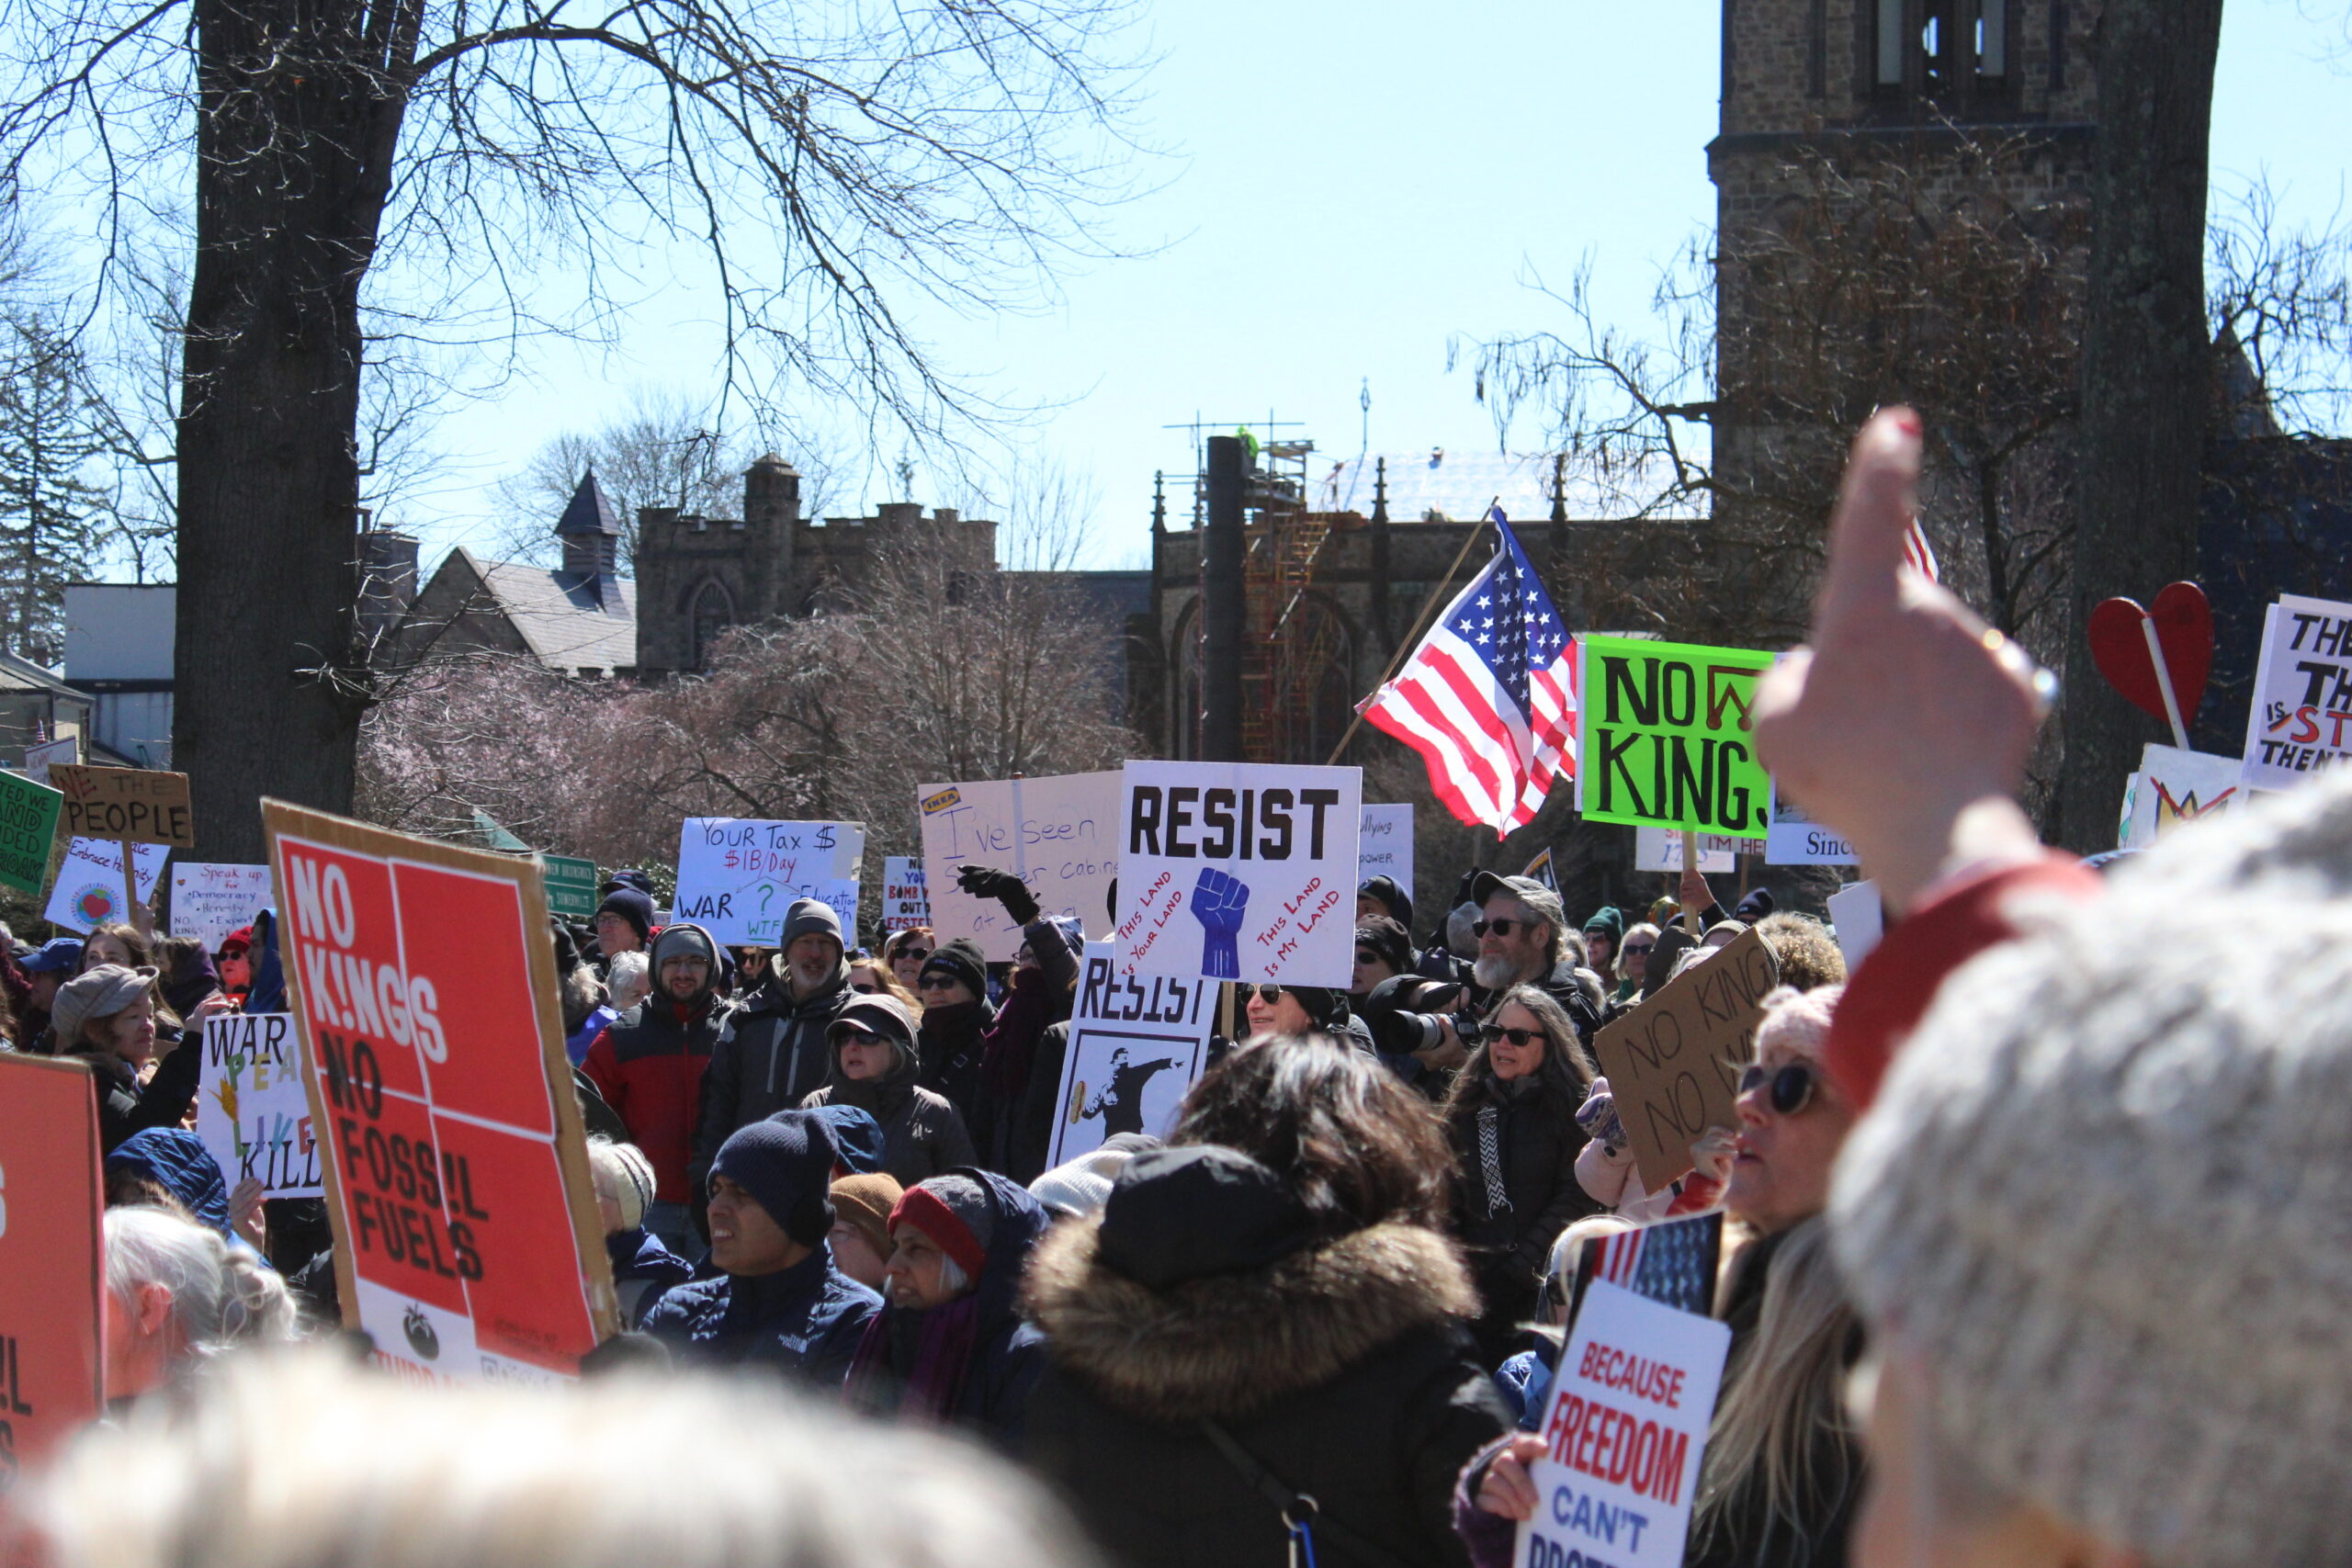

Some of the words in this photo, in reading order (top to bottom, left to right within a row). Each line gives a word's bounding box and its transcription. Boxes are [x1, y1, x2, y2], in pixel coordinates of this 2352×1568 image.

[1600, 656, 1695, 727] NO
[2267, 702, 2285, 721] IS
[29, 791, 50, 812] WE
[49, 766, 96, 805] WE
[109, 774, 179, 795] THE
[927, 793, 956, 809] IKEA
[68, 801, 188, 840] PEOPLE
[701, 818, 755, 846] YOUR
[766, 824, 801, 850] Tax
[813, 824, 836, 852] $
[1130, 785, 1339, 861] RESIST
[70, 840, 110, 867] Embrace
[1708, 835, 1731, 851] I'M
[200, 865, 240, 882] Speak
[248, 872, 263, 882] up
[192, 890, 256, 903] Democracy
[290, 855, 355, 948] NO
[678, 893, 733, 919] WAR
[758, 885, 774, 916] ?
[900, 902, 922, 914] OUT
[1118, 911, 1142, 940] THIS
[1140, 872, 1170, 908] LAND
[1154, 891, 1182, 928] LAND
[1257, 917, 1286, 946] THIS
[1283, 877, 1321, 915] LAND
[974, 909, 995, 931] at
[1277, 937, 1297, 962] MY
[1297, 891, 1339, 933] LAND
[208, 1016, 287, 1067] WAR
[1624, 1010, 1681, 1079] NO
[320, 1030, 382, 1122] NO
[1645, 1071, 1705, 1156] NO
[353, 1189, 483, 1282] FUELS
[1578, 1341, 1687, 1409] BECAUSE
[1546, 1391, 1690, 1506] FREEDOM
[1553, 1484, 1649, 1553] CAN'T
